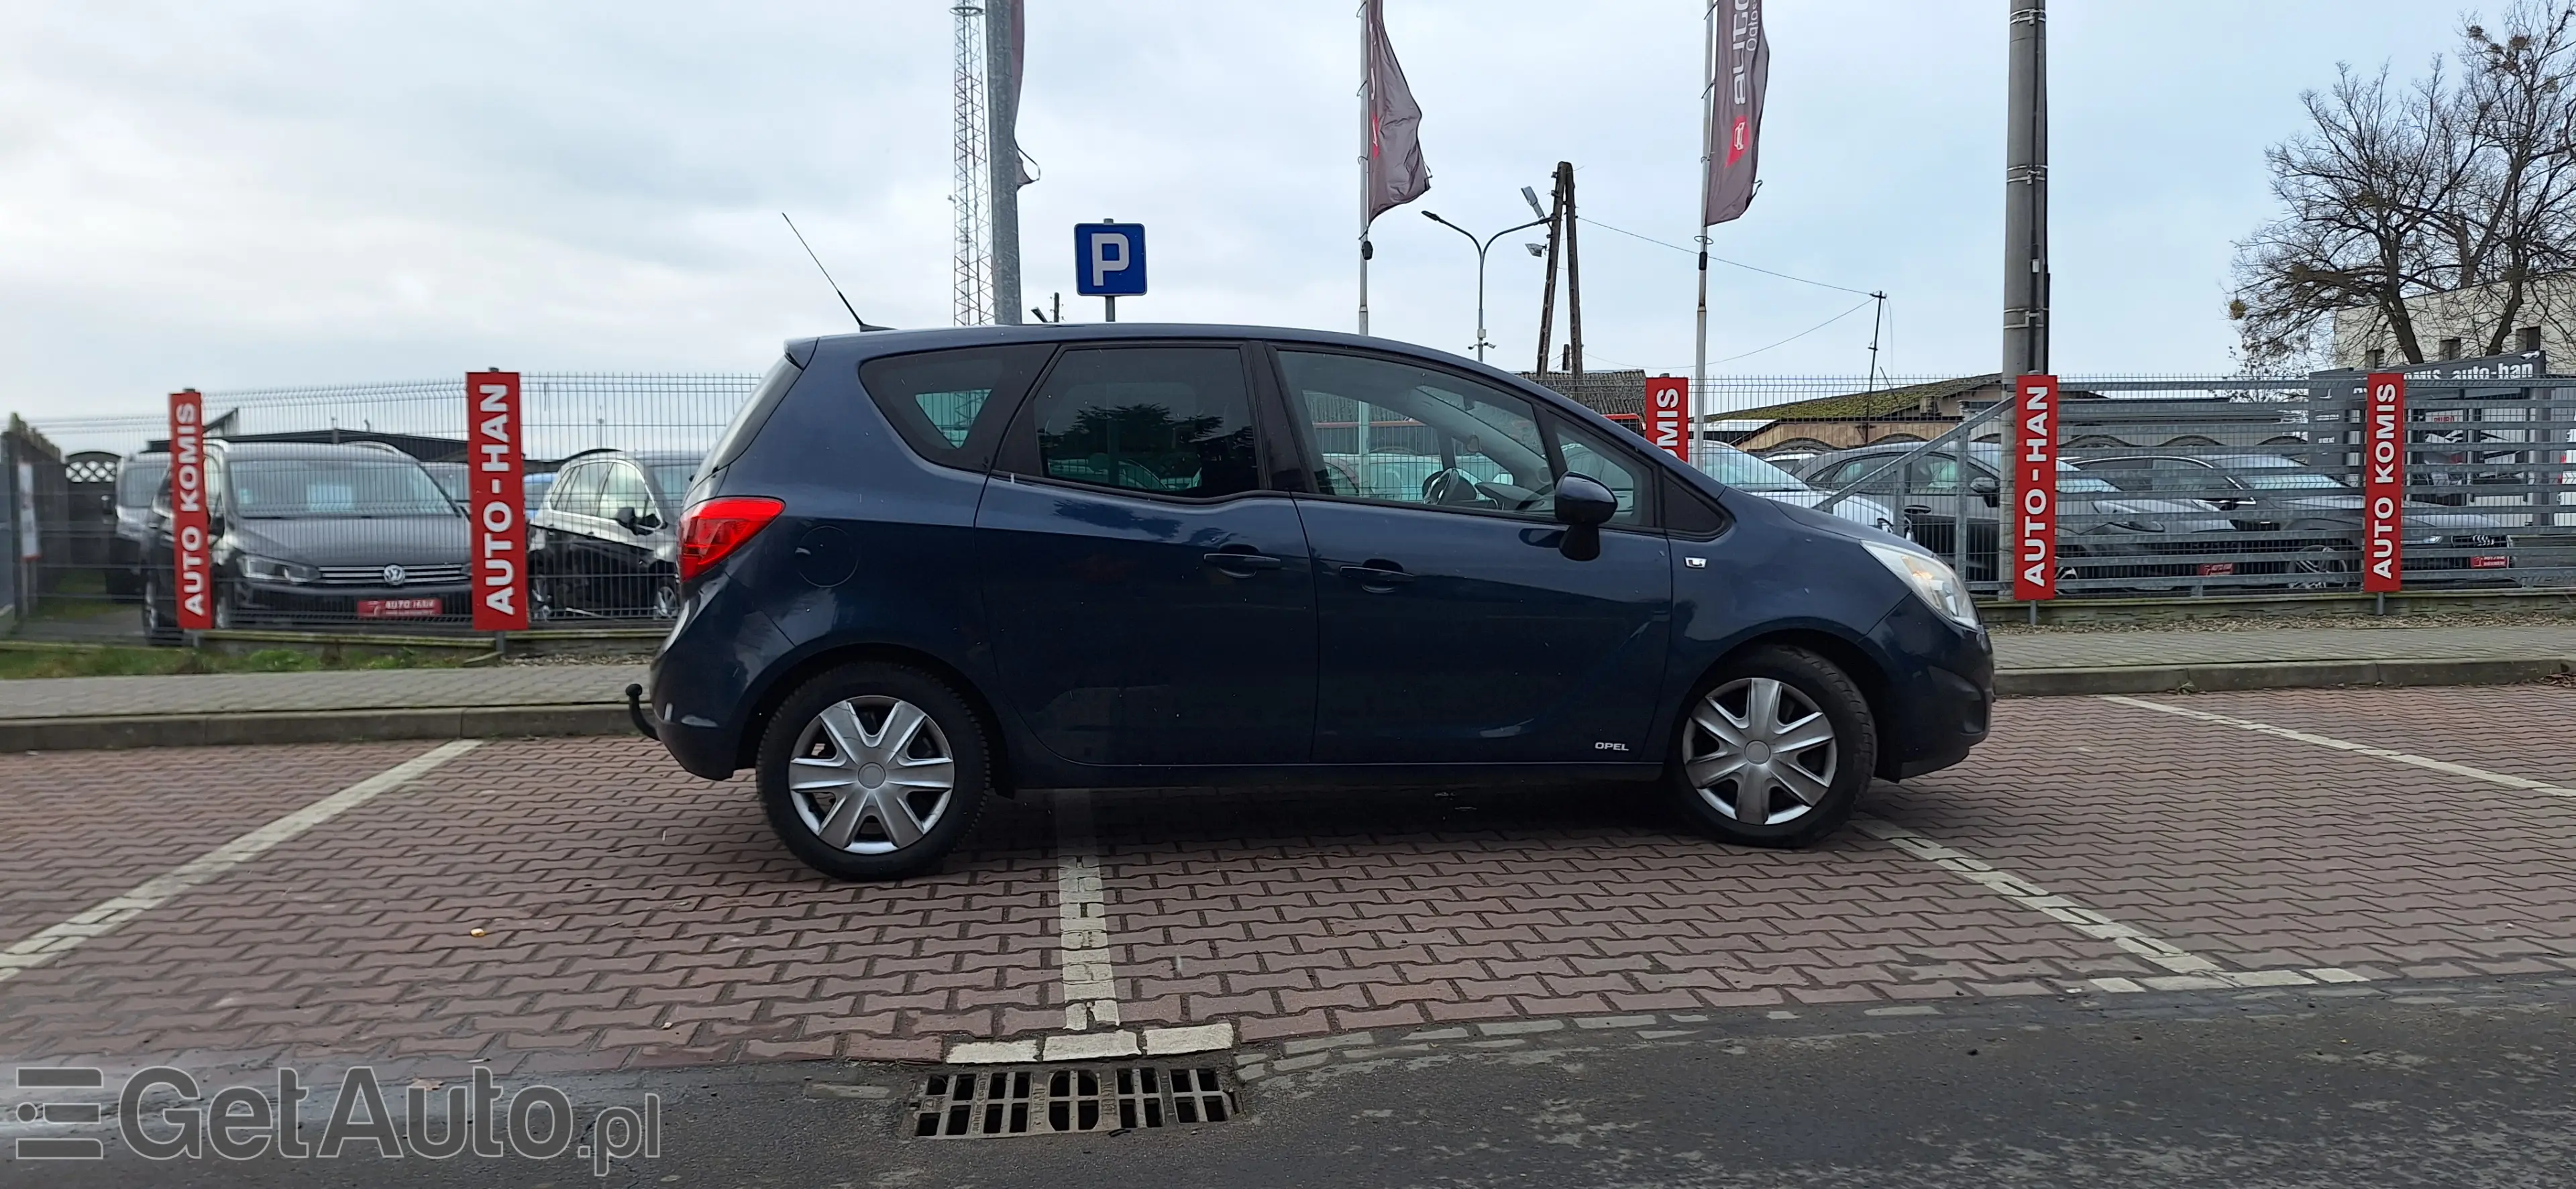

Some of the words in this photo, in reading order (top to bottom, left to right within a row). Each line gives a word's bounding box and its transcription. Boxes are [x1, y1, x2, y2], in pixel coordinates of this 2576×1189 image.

[1091, 233, 1130, 286] P
[176, 403, 199, 512] KOMIS
[1656, 388, 1679, 458] MIS
[2375, 384, 2396, 484] KOMIS
[181, 526, 204, 616] AUTO
[2373, 497, 2394, 579] AUTO
[1595, 742, 1629, 751] OPEL
